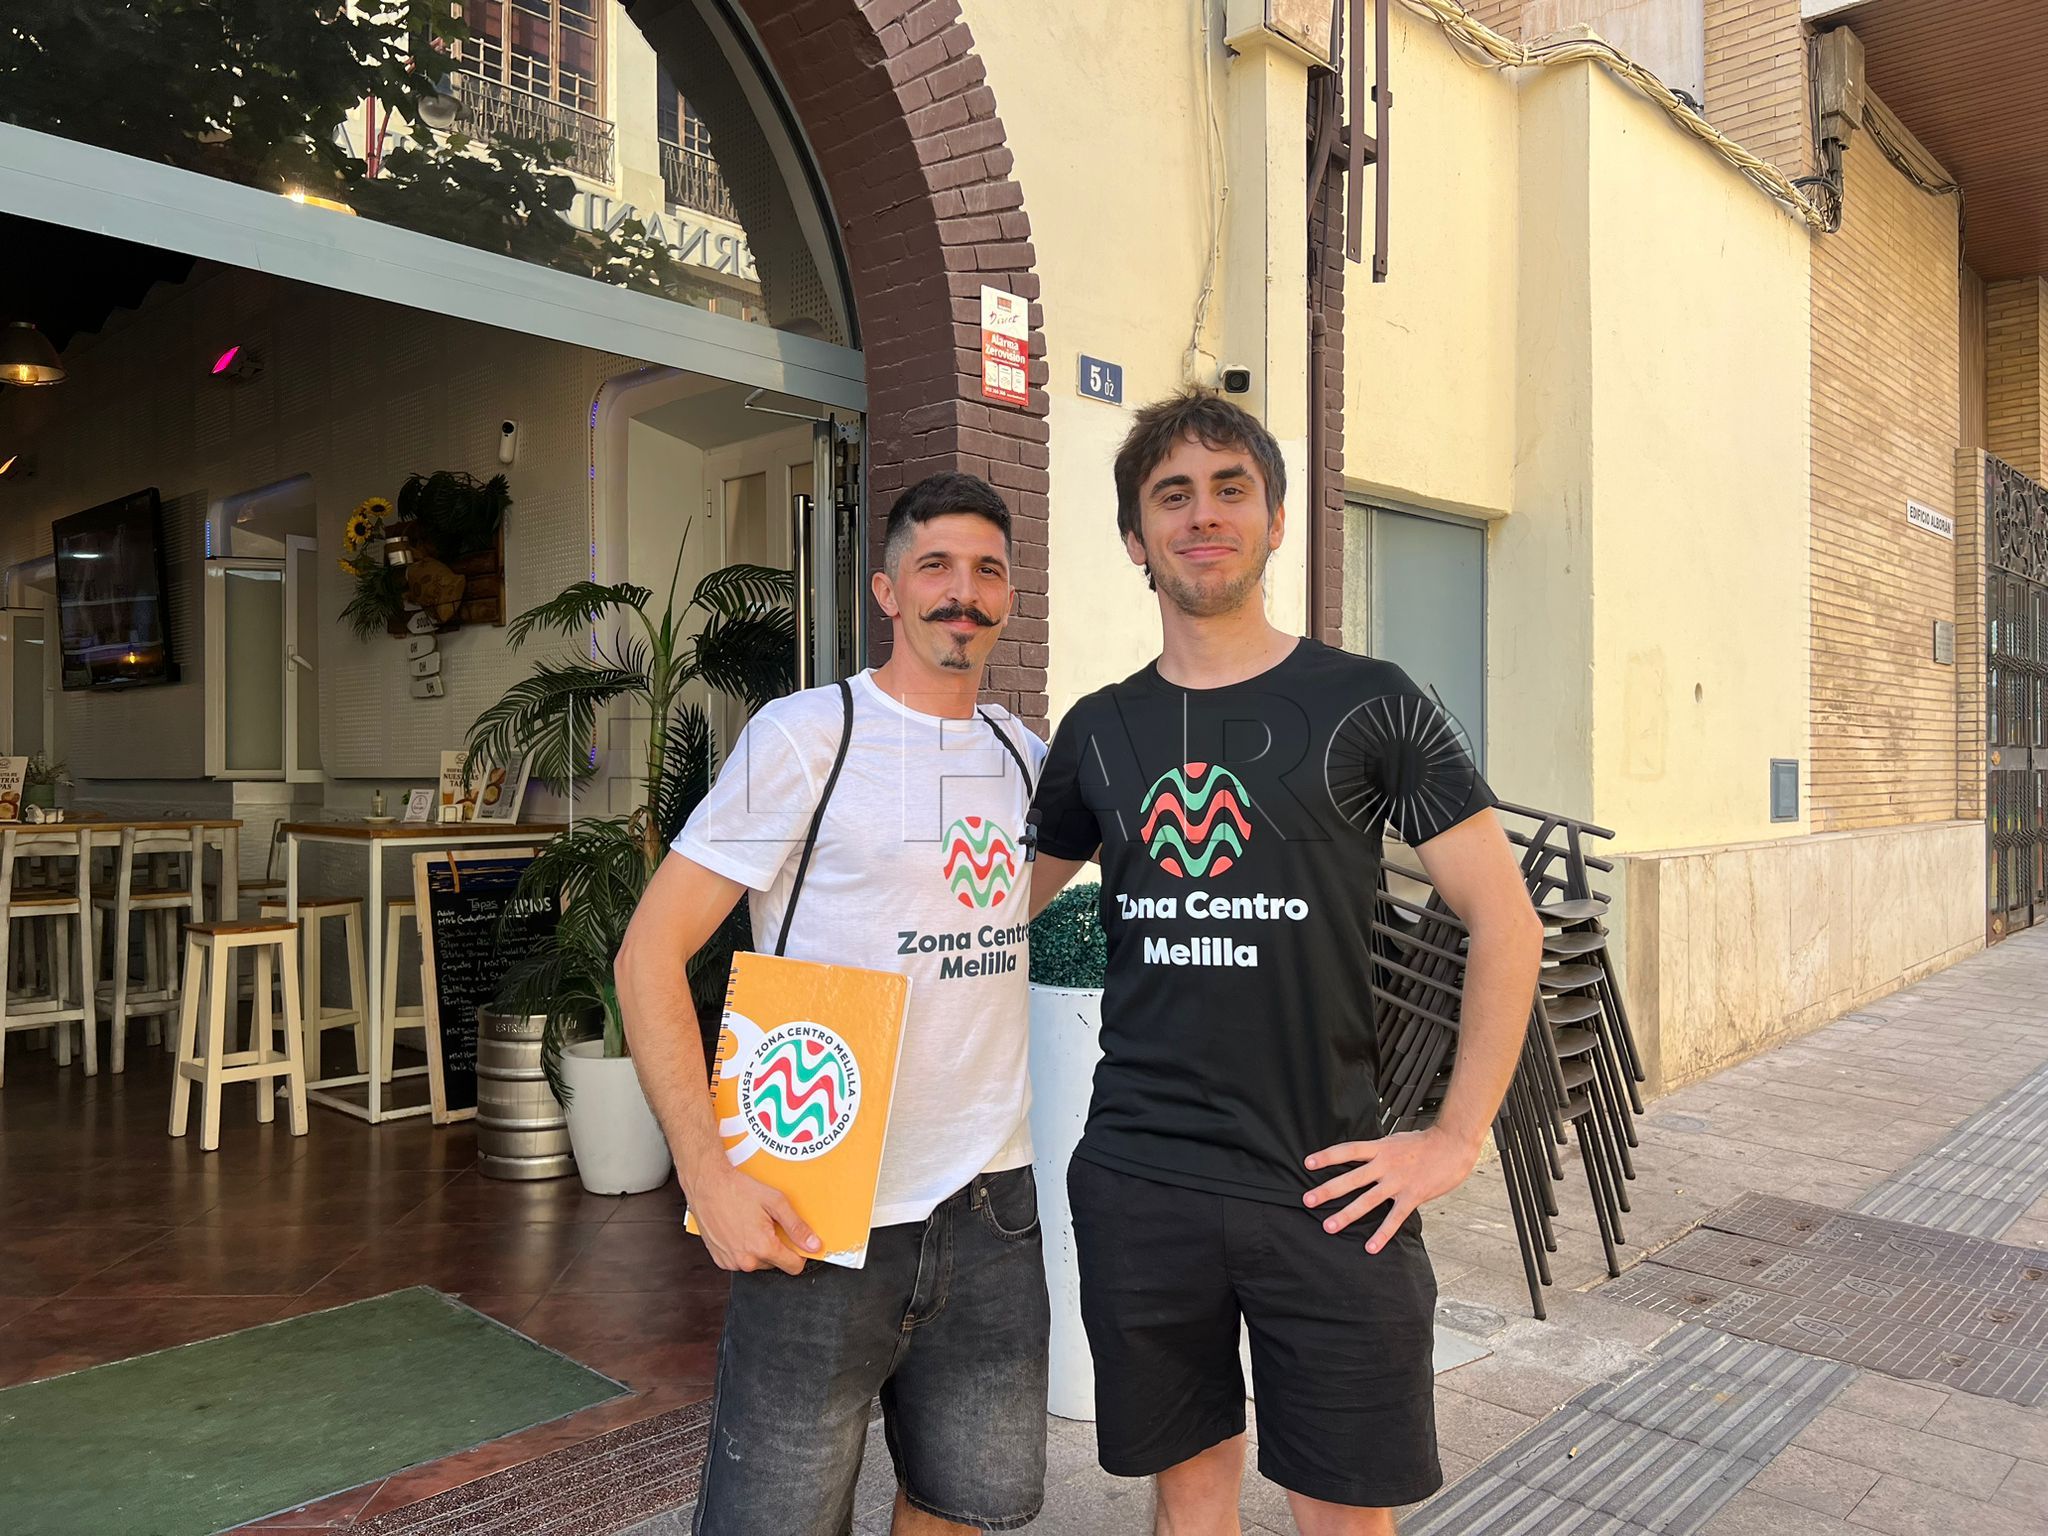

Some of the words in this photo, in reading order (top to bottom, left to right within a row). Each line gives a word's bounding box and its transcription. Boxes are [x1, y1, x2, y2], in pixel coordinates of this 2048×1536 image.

[991, 334, 1019, 351] Alarma
[1090, 365, 1102, 392] 5
[1106, 368, 1112, 383] L
[1104, 381, 1115, 397] 02
[1910, 506, 1930, 525] EDIFICIO
[466, 897, 499, 912] Tapas
[1184, 890, 1310, 922] Centro
[897, 929, 972, 955] Zona
[1143, 936, 1258, 968] Melilla
[939, 950, 1017, 980] Melilla
[754, 1031, 785, 1059] ZONA
[787, 1026, 835, 1047] CENTRO
[833, 1043, 857, 1099] MELILLA
[741, 1071, 799, 1157] ESTABLECIMIENTO
[800, 1112, 851, 1157] ASOCIADO
